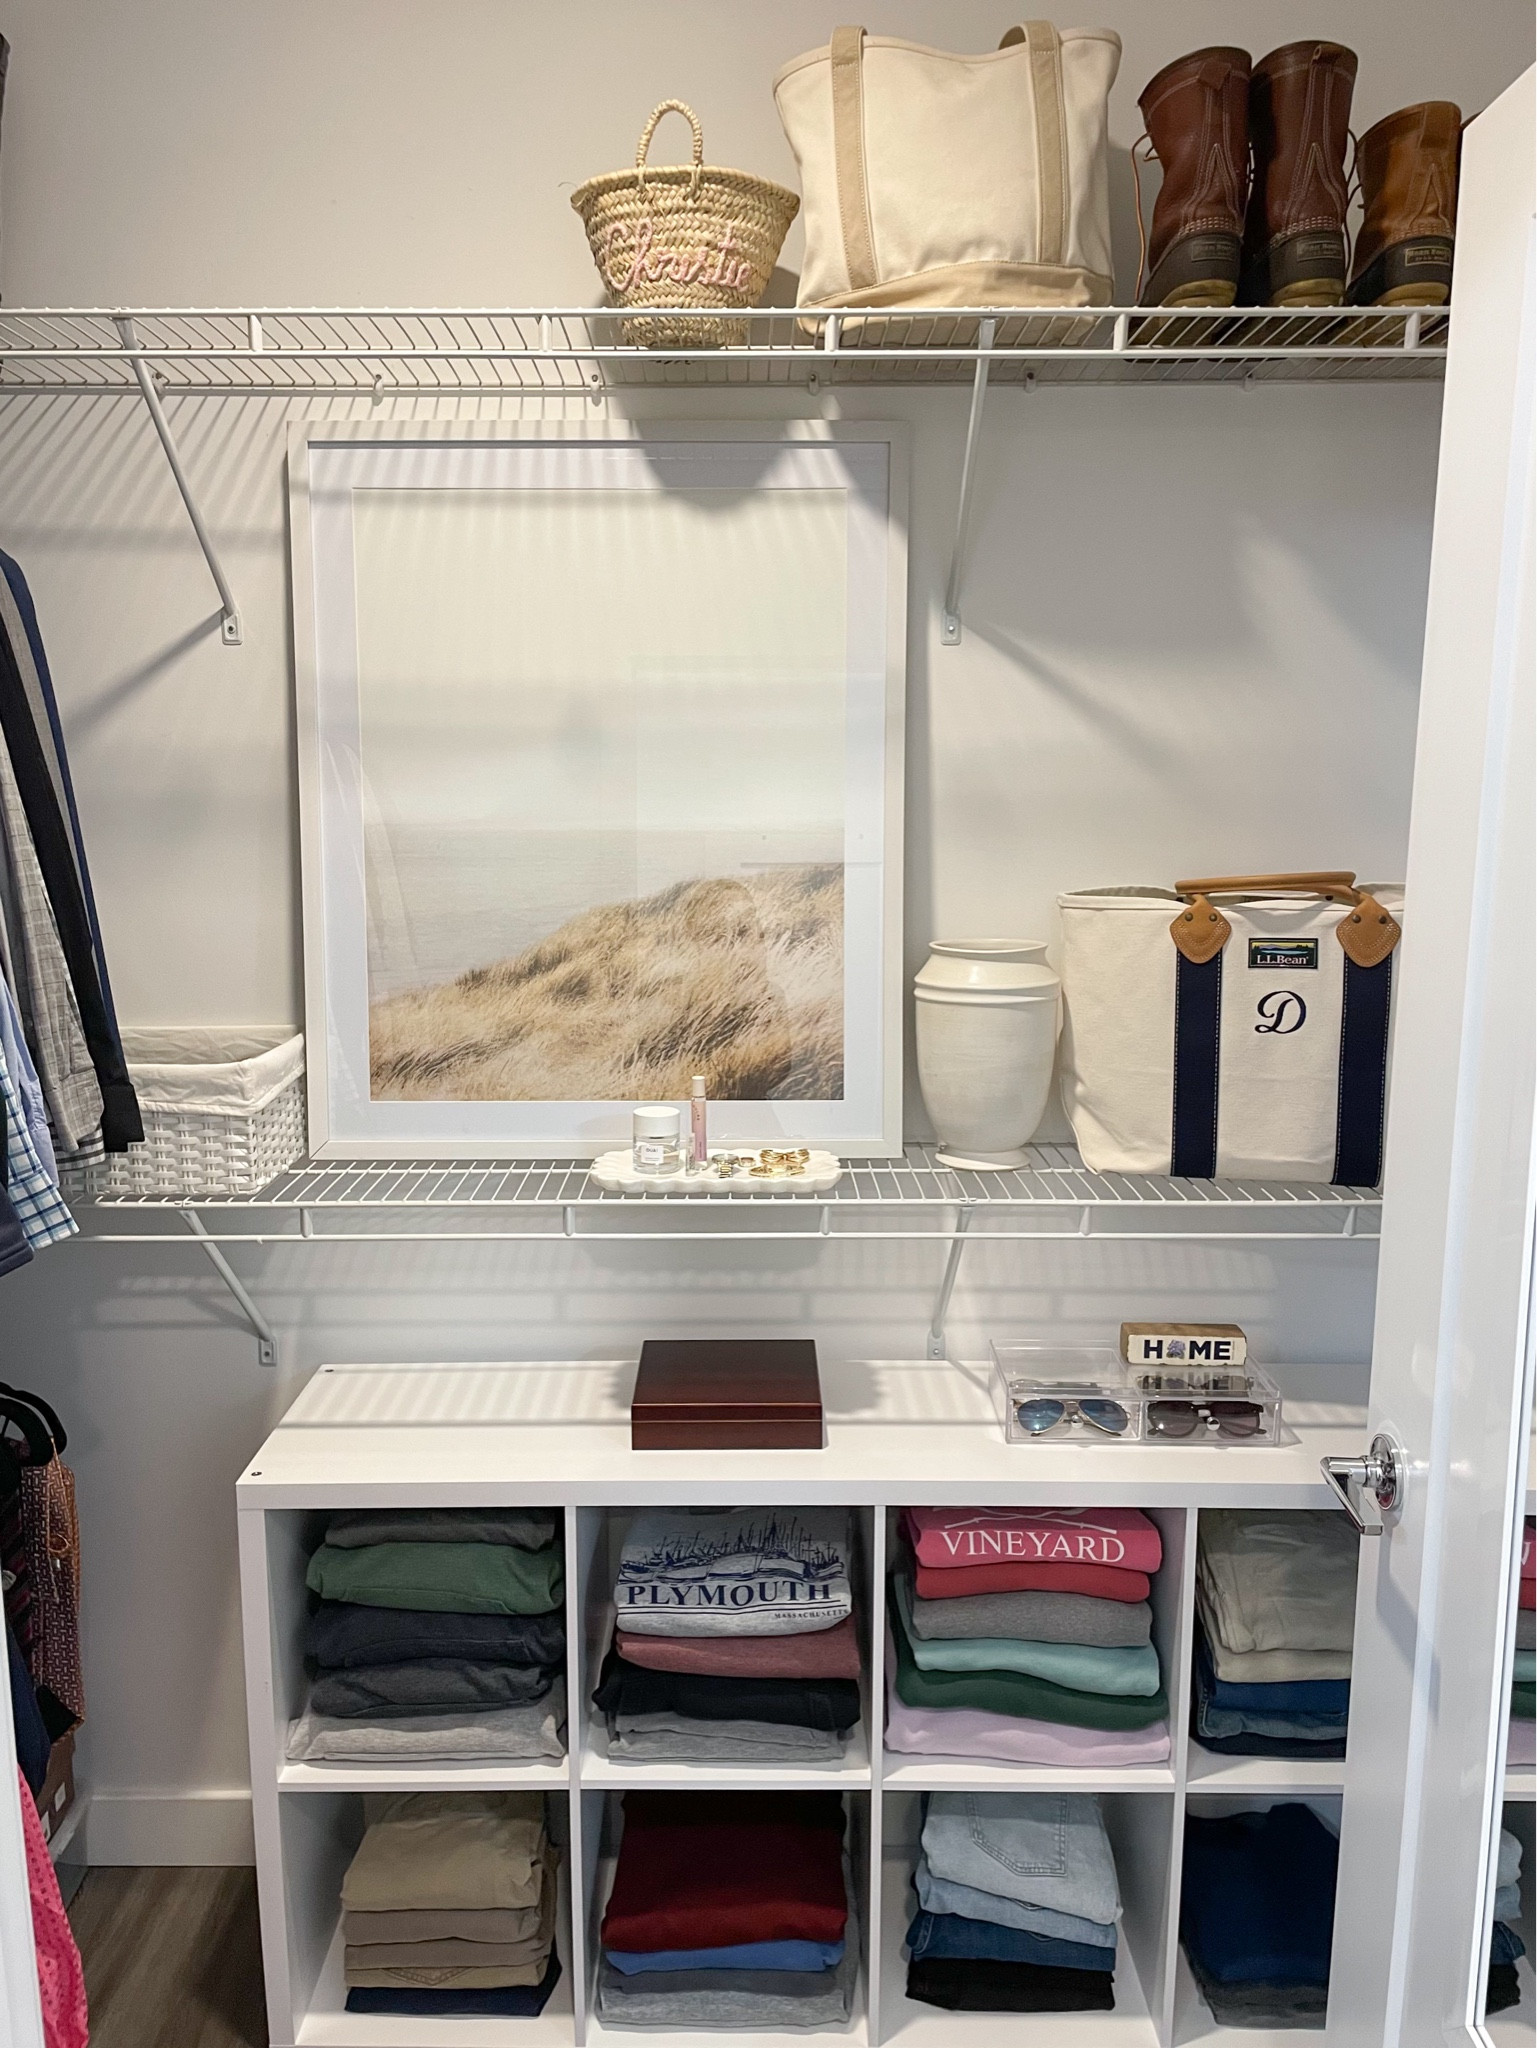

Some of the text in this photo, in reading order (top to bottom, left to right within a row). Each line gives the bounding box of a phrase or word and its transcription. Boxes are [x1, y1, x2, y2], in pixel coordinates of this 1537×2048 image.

[1254, 990, 1307, 1034] D
[1143, 1339, 1231, 1360] HME
[940, 1530, 1125, 1563] VINEYARD
[627, 1580, 831, 1606] PLYMOUTH
[774, 1609, 849, 1619] MASSACHUSETTS
